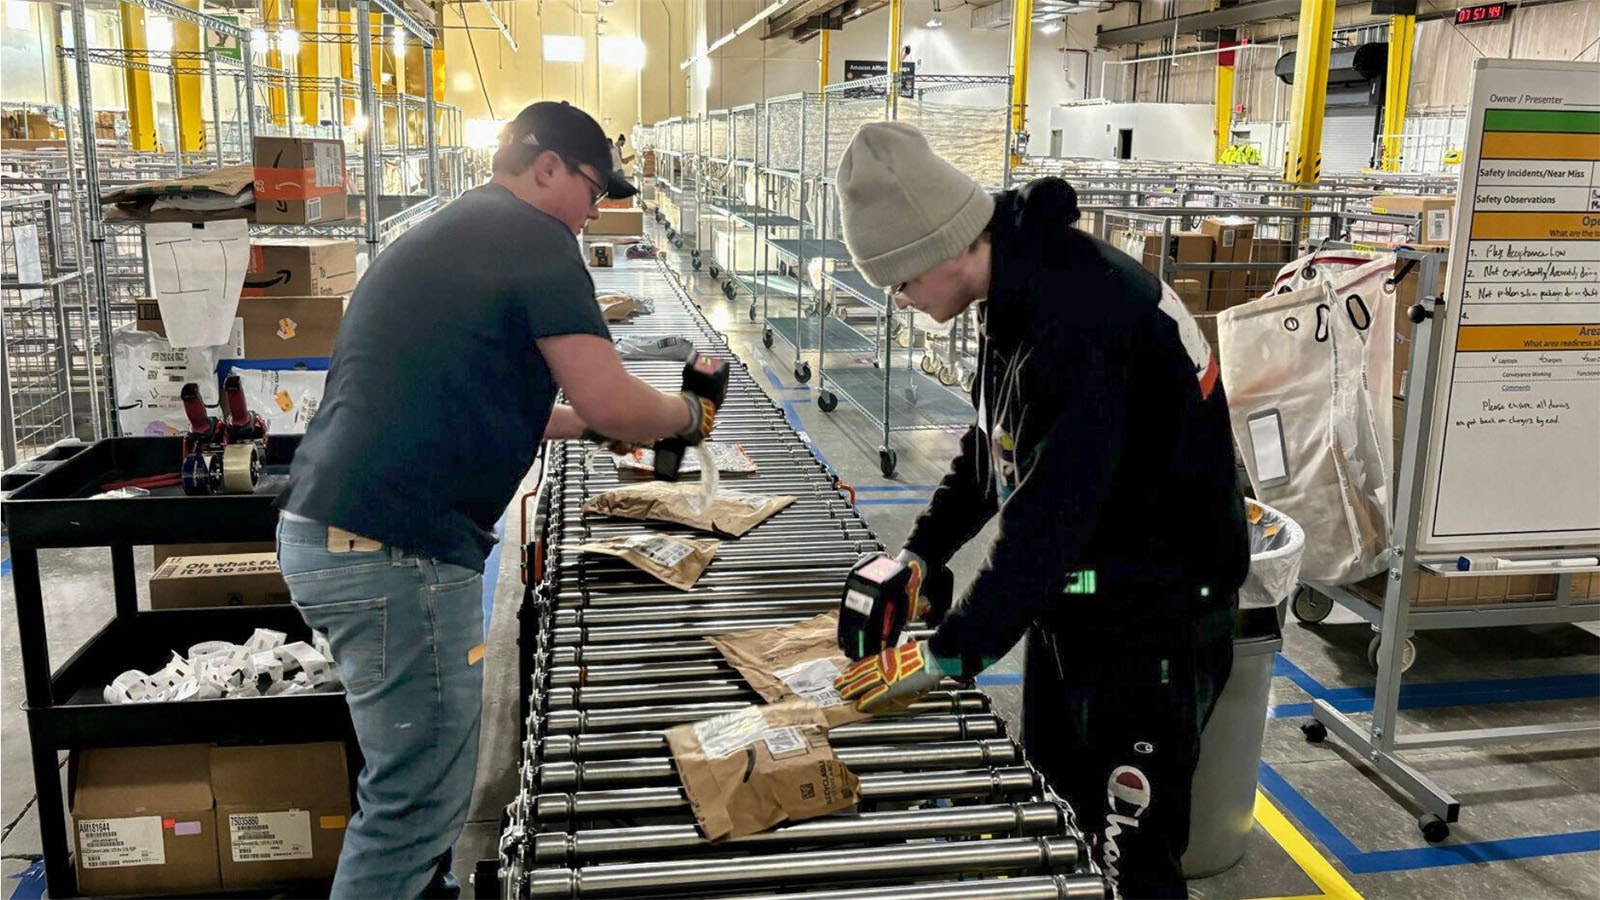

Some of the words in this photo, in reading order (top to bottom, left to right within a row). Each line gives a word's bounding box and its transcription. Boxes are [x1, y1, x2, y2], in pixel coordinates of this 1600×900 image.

[1490, 94, 1518, 103] Owner
[1525, 94, 1563, 104] Presenter
[1479, 168, 1506, 179] Safety
[1507, 169, 1566, 179] Incidents/Near
[1568, 170, 1585, 178] Miss
[1476, 194, 1502, 206] Safety
[1504, 195, 1556, 205] Observations
[1549, 230, 1567, 238] What
[1582, 230, 1594, 238] the
[1484, 265, 1499, 278] Not
[1478, 288, 1492, 300] Not
[1523, 339, 1544, 348] What
[1502, 371, 1531, 379] Conveyance
[1482, 398, 1505, 412] Please
[213, 560, 256, 568] what
